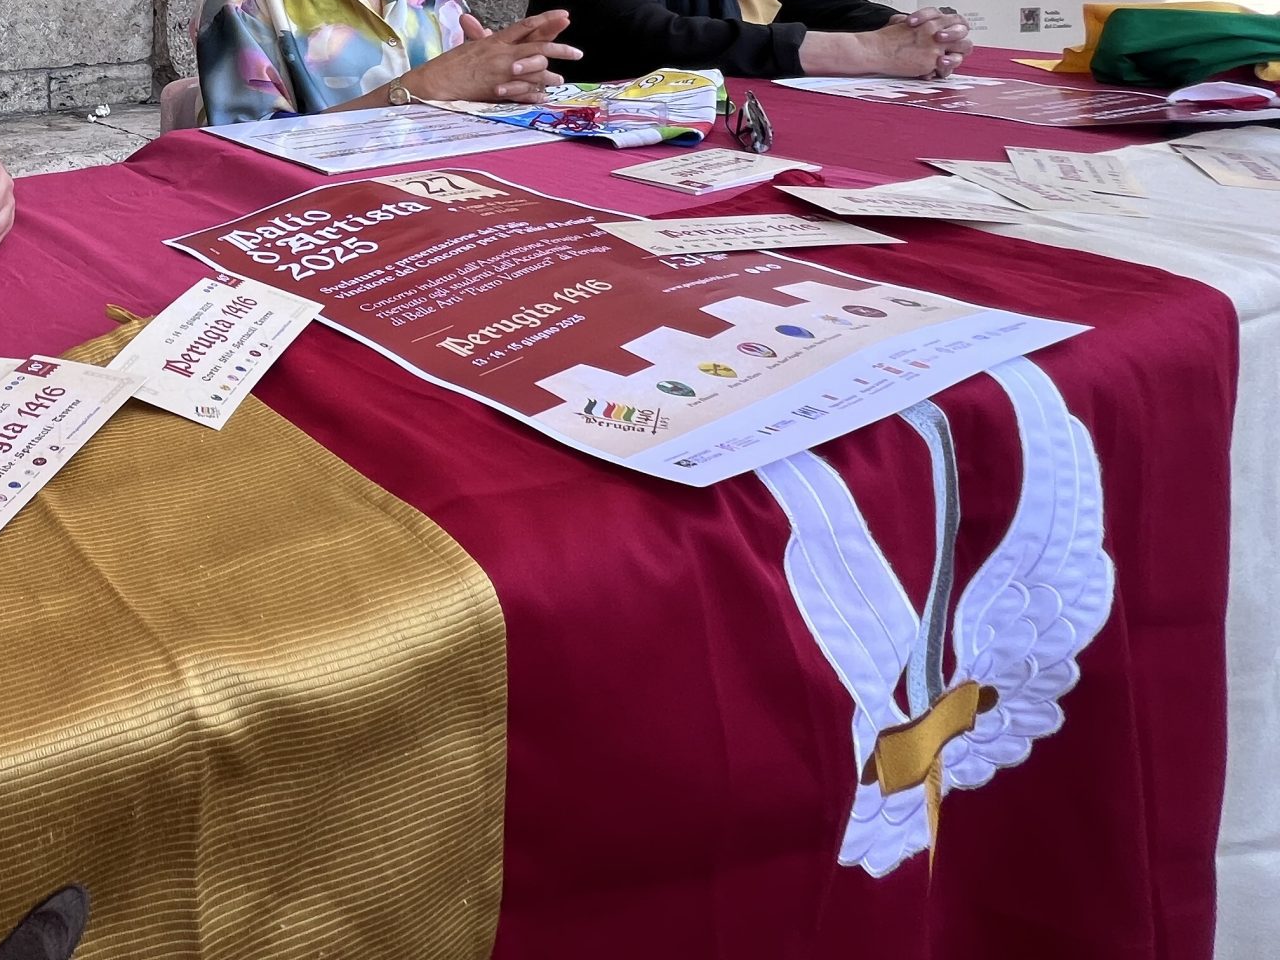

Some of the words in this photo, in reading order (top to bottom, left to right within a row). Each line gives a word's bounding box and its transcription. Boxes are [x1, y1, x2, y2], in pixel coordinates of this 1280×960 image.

[406, 176, 465, 194] 27
[218, 210, 332, 251] Palio
[655, 225, 765, 238] Perugia
[274, 237, 379, 281] 2025
[320, 269, 385, 294] Svelatura
[395, 233, 479, 267] presentazione
[477, 226, 495, 235] del
[334, 275, 395, 300] vincitore
[395, 265, 418, 277] del
[415, 242, 477, 268] Concorso
[476, 235, 498, 246] per
[360, 289, 418, 311] Concorso
[416, 273, 457, 290] indetto
[376, 296, 427, 319] riservato
[429, 287, 450, 299] agli
[450, 267, 495, 291] studenti
[391, 315, 405, 327] di
[404, 305, 436, 321] Belle
[436, 294, 464, 309] Arti
[161, 318, 236, 378] Perugia
[221, 296, 258, 320] 1416
[436, 302, 563, 357] Perugia
[553, 279, 613, 304] 1416
[472, 357, 488, 367] 13
[489, 350, 506, 359] 14
[507, 342, 523, 352] 15
[521, 326, 561, 347] giugno
[557, 314, 586, 329] 2025
[17, 385, 66, 419] 1416
[14, 424, 55, 460] Spettacoli
[584, 417, 646, 433] Perugia
